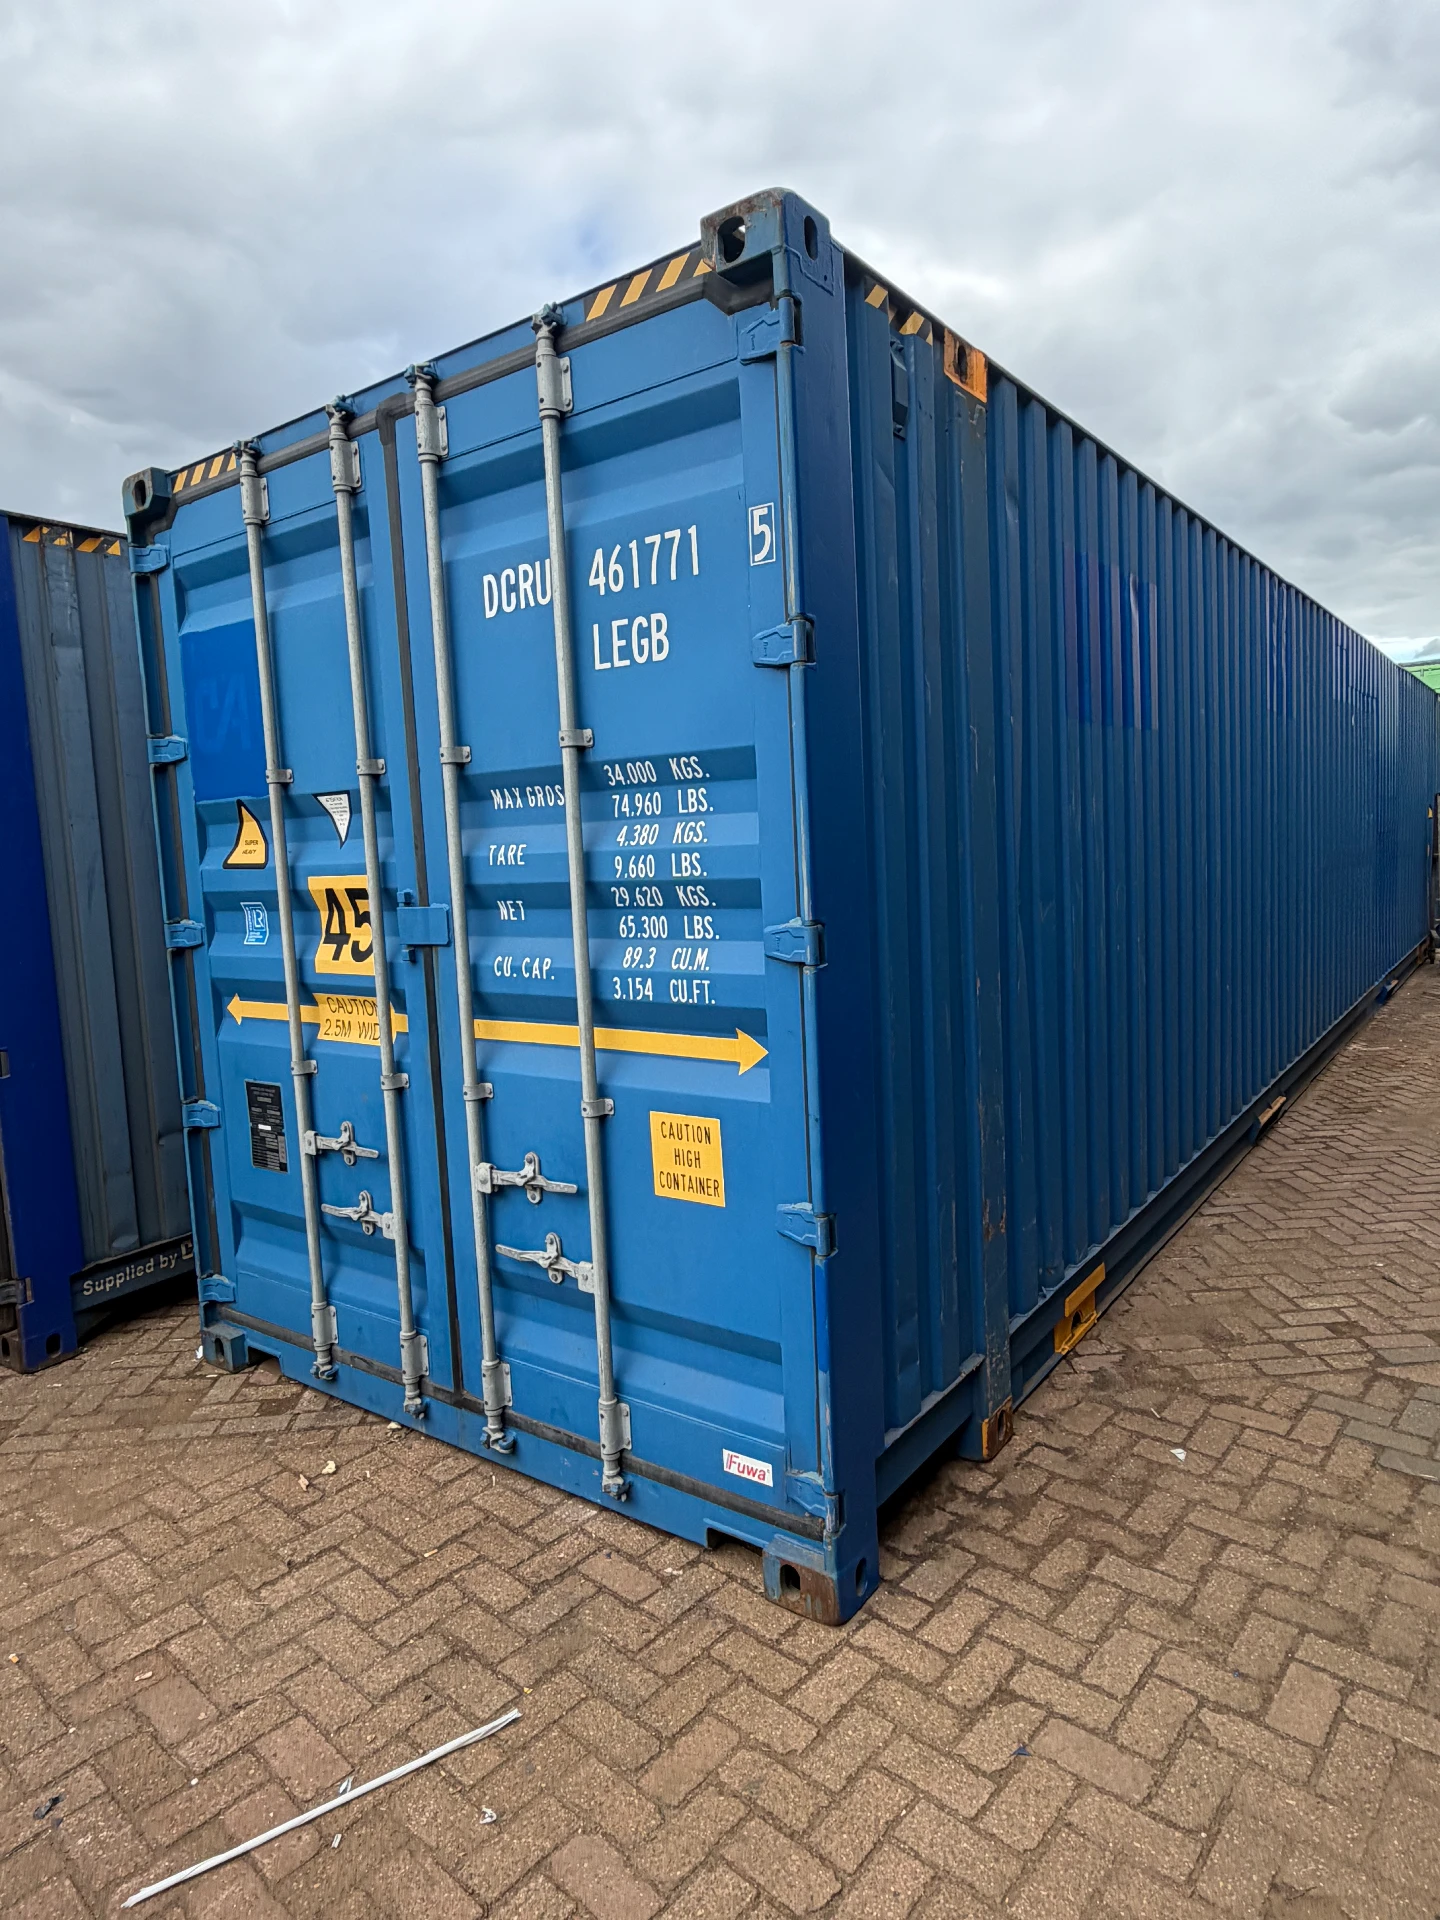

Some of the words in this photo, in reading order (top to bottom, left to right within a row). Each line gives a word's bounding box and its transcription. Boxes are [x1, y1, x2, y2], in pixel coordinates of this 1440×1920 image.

[482, 558, 551, 619] DCRU
[588, 524, 699, 596] 461771
[753, 507, 772, 562] 5
[592, 612, 670, 670] LEGB
[490, 786, 523, 810] MAX
[525, 784, 565, 808] GROS
[668, 755, 710, 781] KGS.
[677, 787, 714, 814] LBS.
[488, 843, 527, 866] TARE
[672, 820, 708, 844] KGS.
[671, 851, 708, 877] LBS.
[496, 900, 526, 921] NET
[675, 885, 717, 907] KGS.
[322, 887, 374, 963] 45
[683, 914, 720, 940] LBS.
[622, 946, 657, 969] 89.3
[671, 947, 710, 971] CU.M.
[669, 978, 716, 1004] CU.FT.
[324, 1018, 352, 1038] 2.5M
[358, 1020, 381, 1041] WID
[660, 1121, 711, 1145] CAUTION
[674, 1148, 701, 1169] HIGH
[659, 1170, 720, 1197] CONTAINER
[83, 1258, 155, 1296] Supplied
[159, 1252, 178, 1269] by
[726, 1452, 767, 1482] Fuwa
